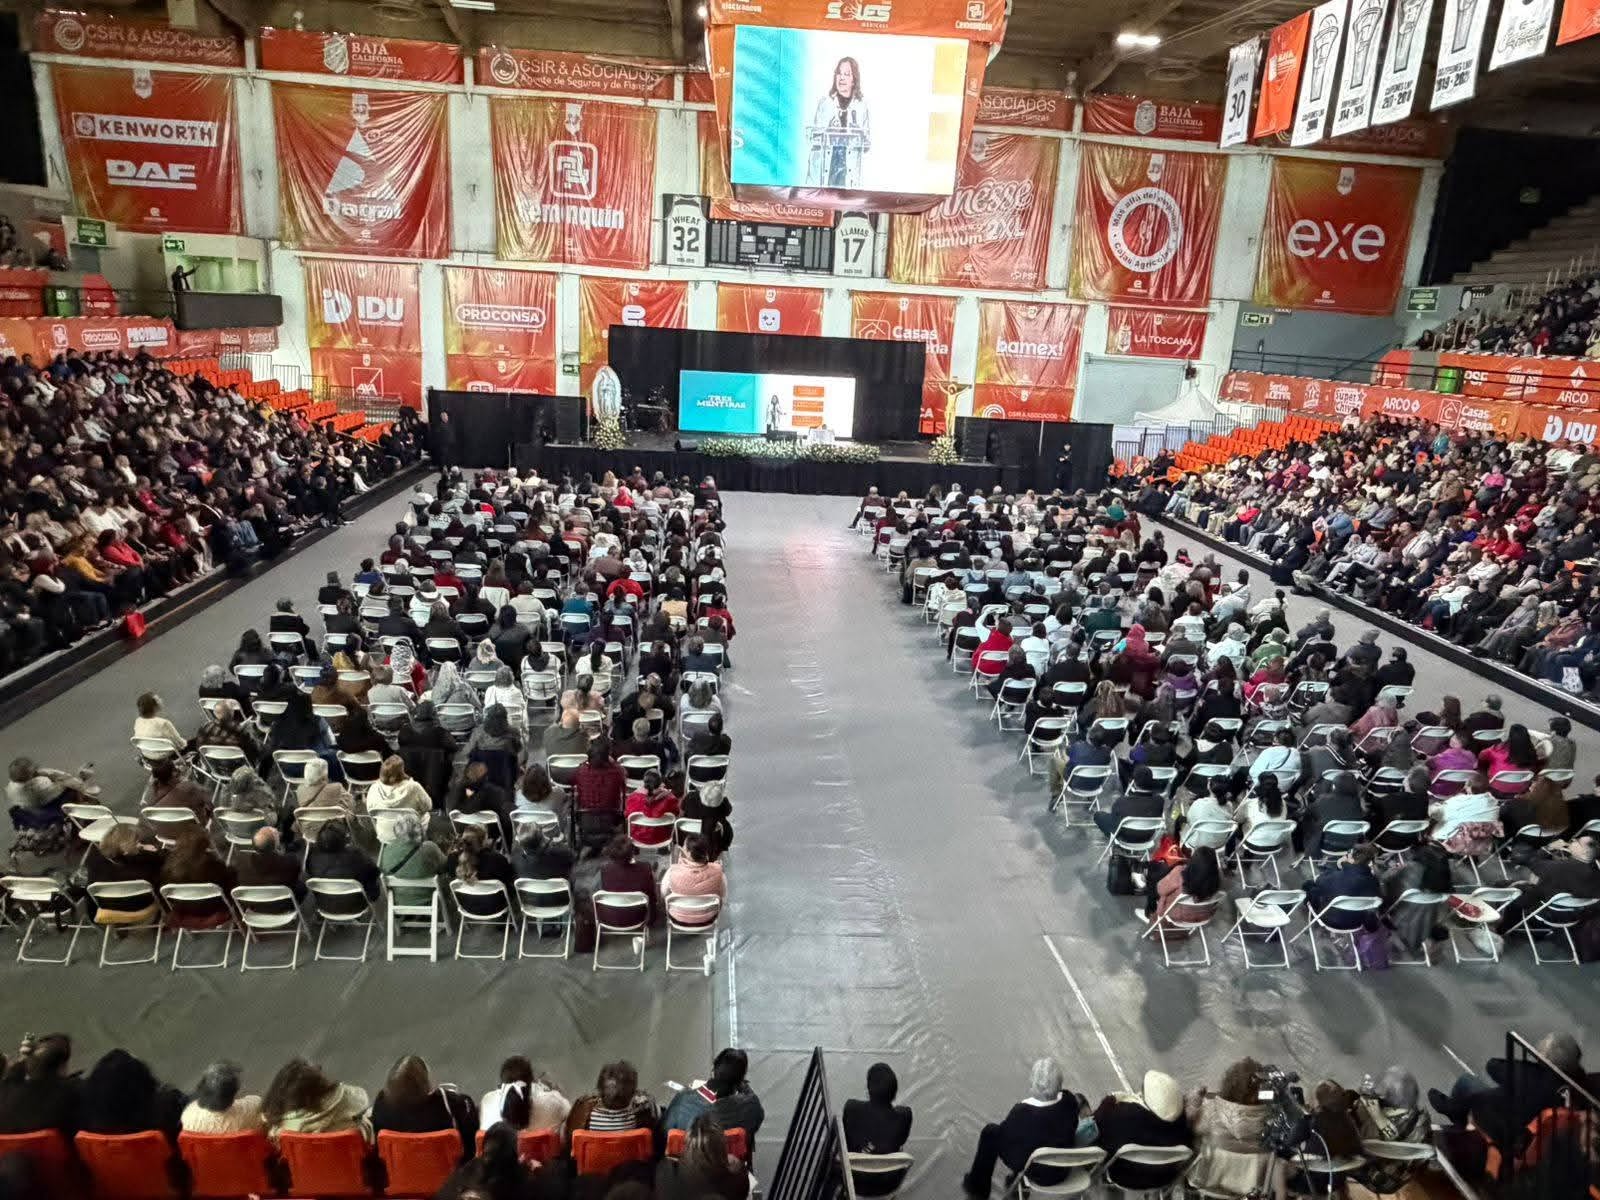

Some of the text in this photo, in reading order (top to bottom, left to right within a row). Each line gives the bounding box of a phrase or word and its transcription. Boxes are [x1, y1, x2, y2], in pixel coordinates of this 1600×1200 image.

[352, 42, 388, 55] BAJA
[352, 54, 404, 64] CALIFORNIA
[520, 60, 661, 82] CSIR & ASOCIADOS
[554, 76, 564, 86] de
[567, 77, 600, 88] Seguros
[610, 80, 621, 88] de
[1160, 106, 1192, 118] BAJA
[1229, 89, 1246, 123] 30
[1159, 116, 1203, 126] CALIFORNIA
[99, 119, 213, 142] KENWORTH
[106, 160, 196, 180] DAF
[672, 216, 701, 225] WHEAT
[673, 226, 700, 252] 32
[840, 227, 870, 238] LLAMAS
[1287, 218, 1386, 262] exe
[843, 238, 866, 263] 17
[357, 295, 404, 321] IDU
[462, 308, 540, 324] PROCONSA
[892, 326, 938, 340] Casas
[1134, 334, 1194, 346] LA TOSCANA
[356, 383, 378, 396] AXA
[1384, 397, 1410, 412] ARCO
[1557, 391, 1589, 404] ARCO
[1461, 406, 1490, 419] Casas
[1458, 417, 1494, 431] Cadena
[1564, 421, 1598, 444] IDU
